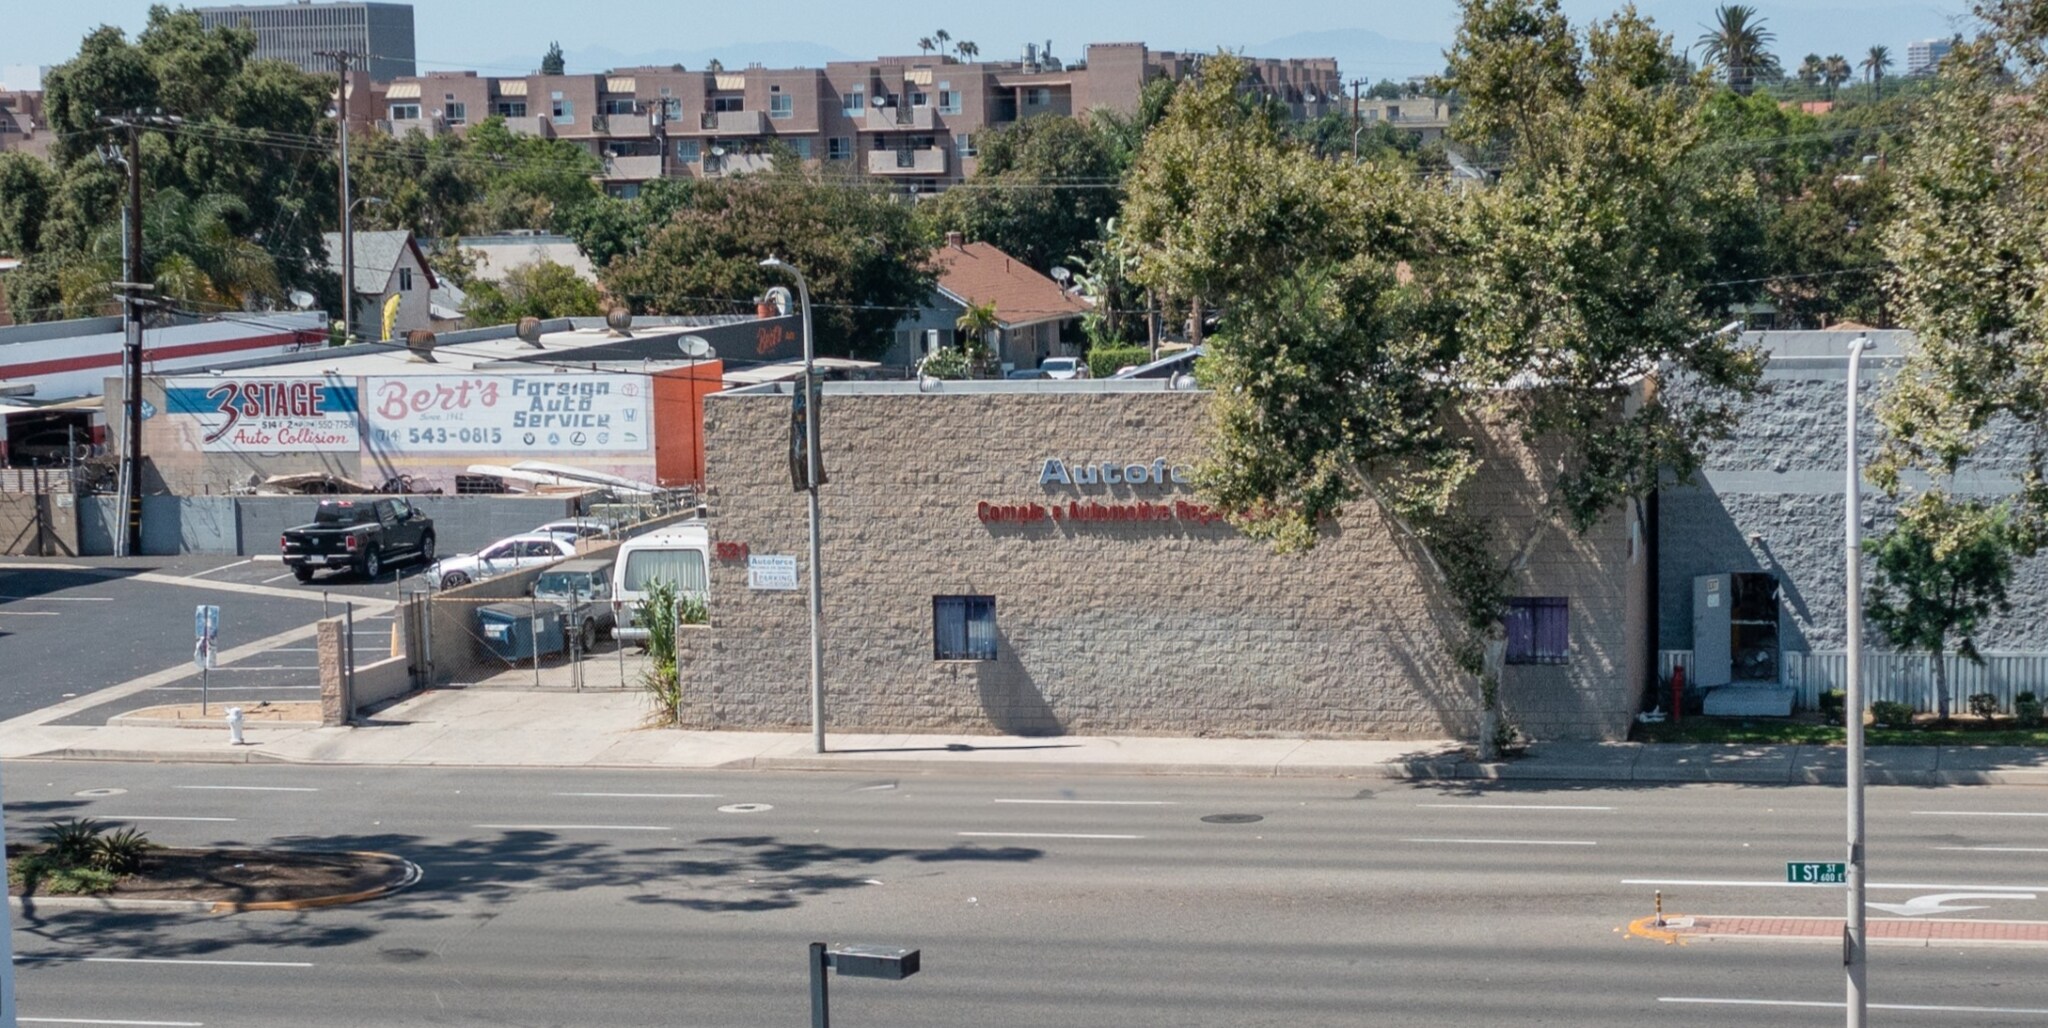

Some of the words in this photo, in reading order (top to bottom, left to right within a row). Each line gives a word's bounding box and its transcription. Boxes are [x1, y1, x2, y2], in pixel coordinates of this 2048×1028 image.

[512, 379, 610, 399] Foreign
[377, 379, 500, 420] Bert's
[529, 396, 592, 412] Auto
[204, 382, 239, 444] 3
[242, 382, 325, 419] STAGE
[513, 411, 611, 429] Service
[233, 427, 272, 445] Auto
[278, 427, 349, 445] Collision
[408, 427, 502, 443] 543-0815
[1038, 457, 1196, 485] Autofo
[1069, 501, 1171, 523] Automotive
[1803, 864, 1820, 881] ST
[1820, 873, 1836, 881] 600
[1838, 873, 1843, 881] E
[1826, 864, 1836, 872] ST
